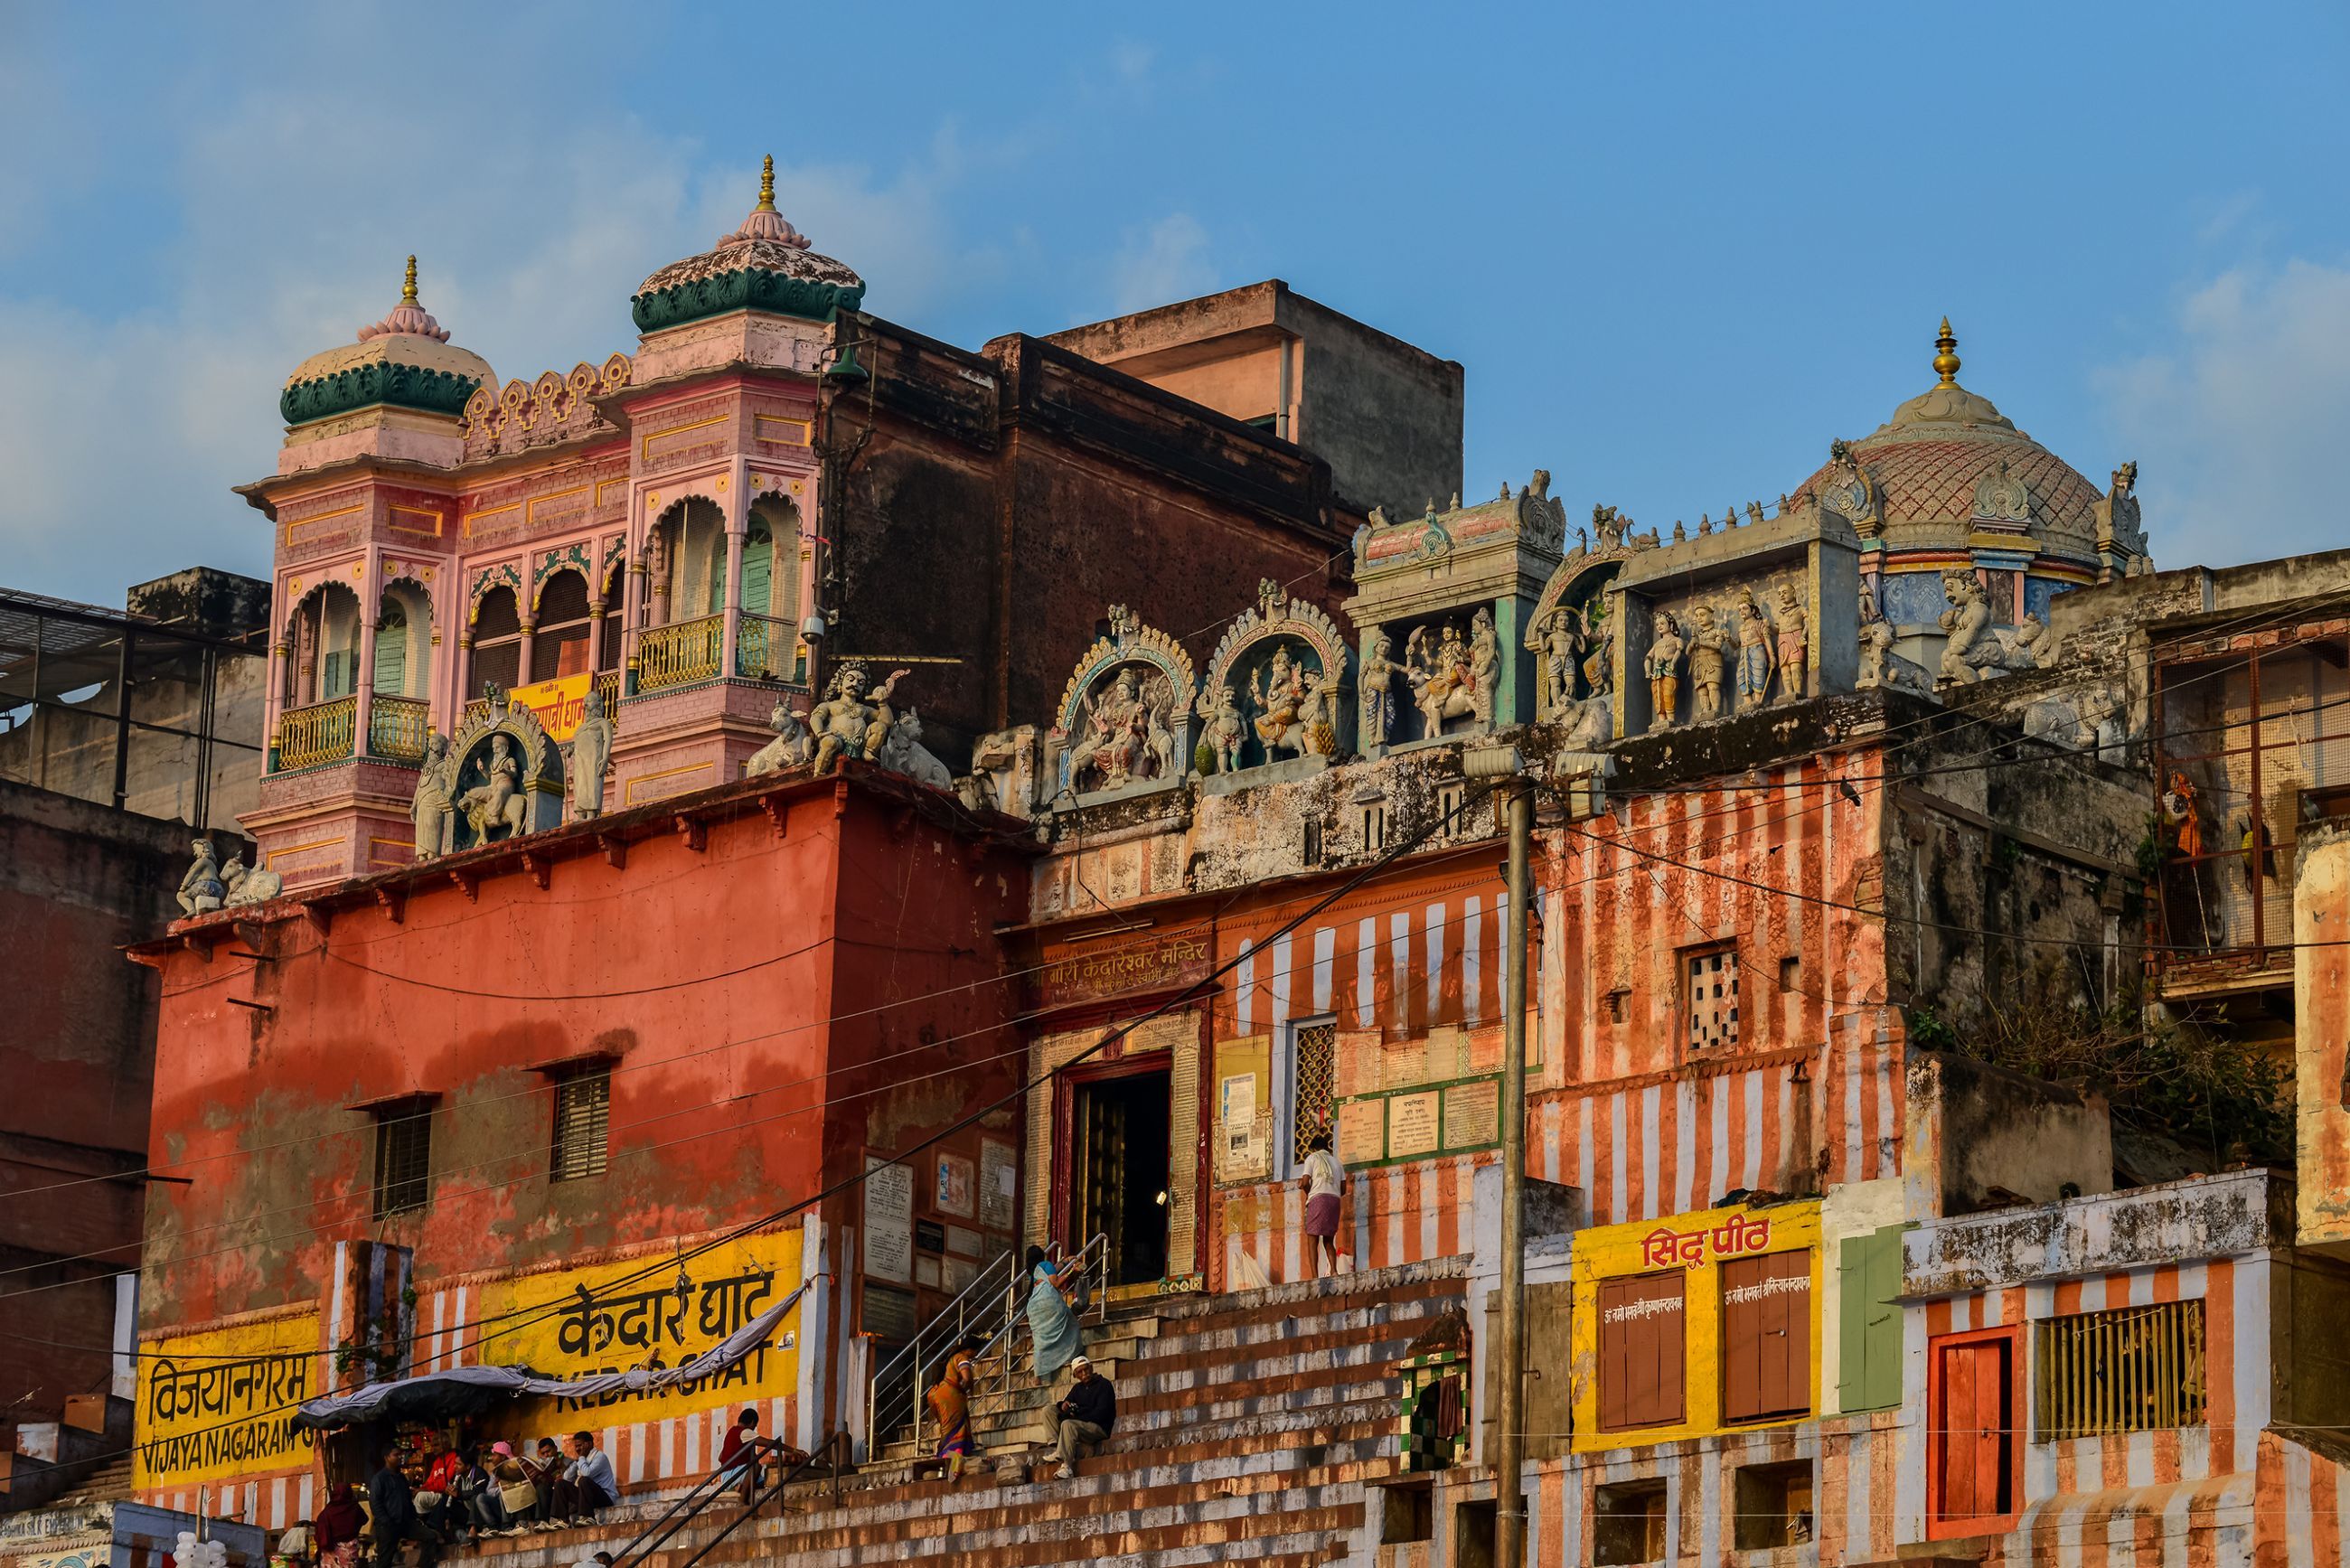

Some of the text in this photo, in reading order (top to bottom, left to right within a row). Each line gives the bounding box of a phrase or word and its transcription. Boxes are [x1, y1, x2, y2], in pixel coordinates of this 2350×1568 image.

[1049, 960, 1078, 984] गौरी
[1161, 939, 1208, 964] मन्दिर
[1712, 1213, 1771, 1255] पीठ
[559, 1270, 775, 1357] केदार घाट
[1612, 1304, 1624, 1322] नमो
[1733, 1285, 1744, 1304] नमो
[148, 1355, 307, 1425] विजयानगरम
